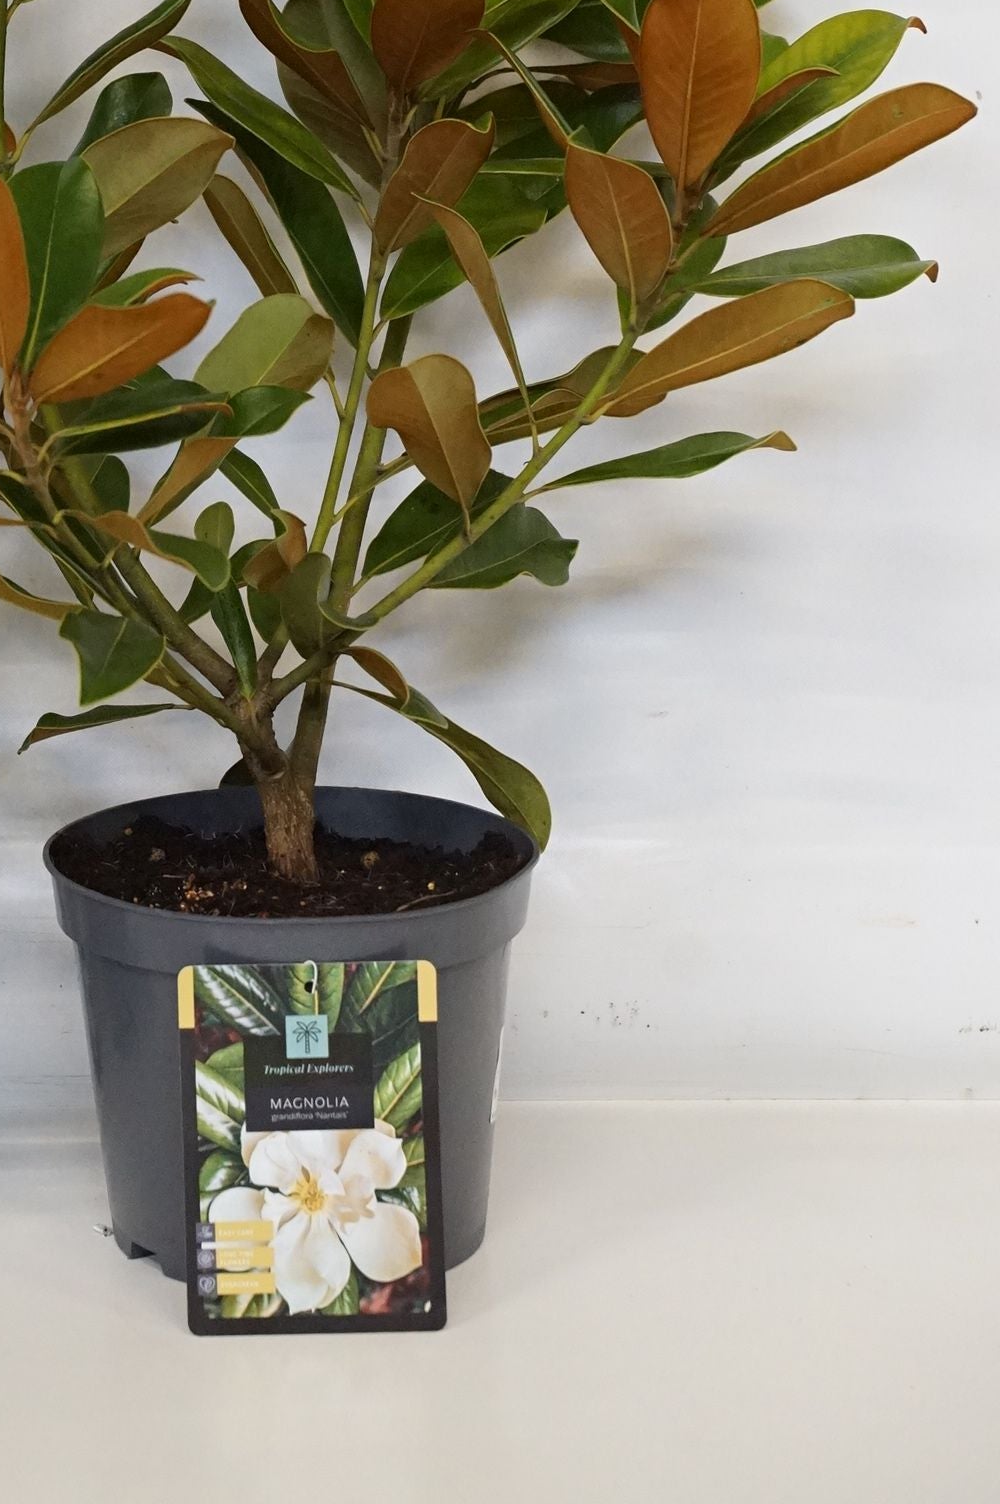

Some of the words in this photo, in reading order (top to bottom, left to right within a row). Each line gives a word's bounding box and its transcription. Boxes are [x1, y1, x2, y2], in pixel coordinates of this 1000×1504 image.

[264, 1063, 306, 1076] Tropical
[307, 1062, 354, 1075] Explorers
[270, 1096, 349, 1109] MAGNOLIA
[271, 1112, 314, 1122] grandiflora
